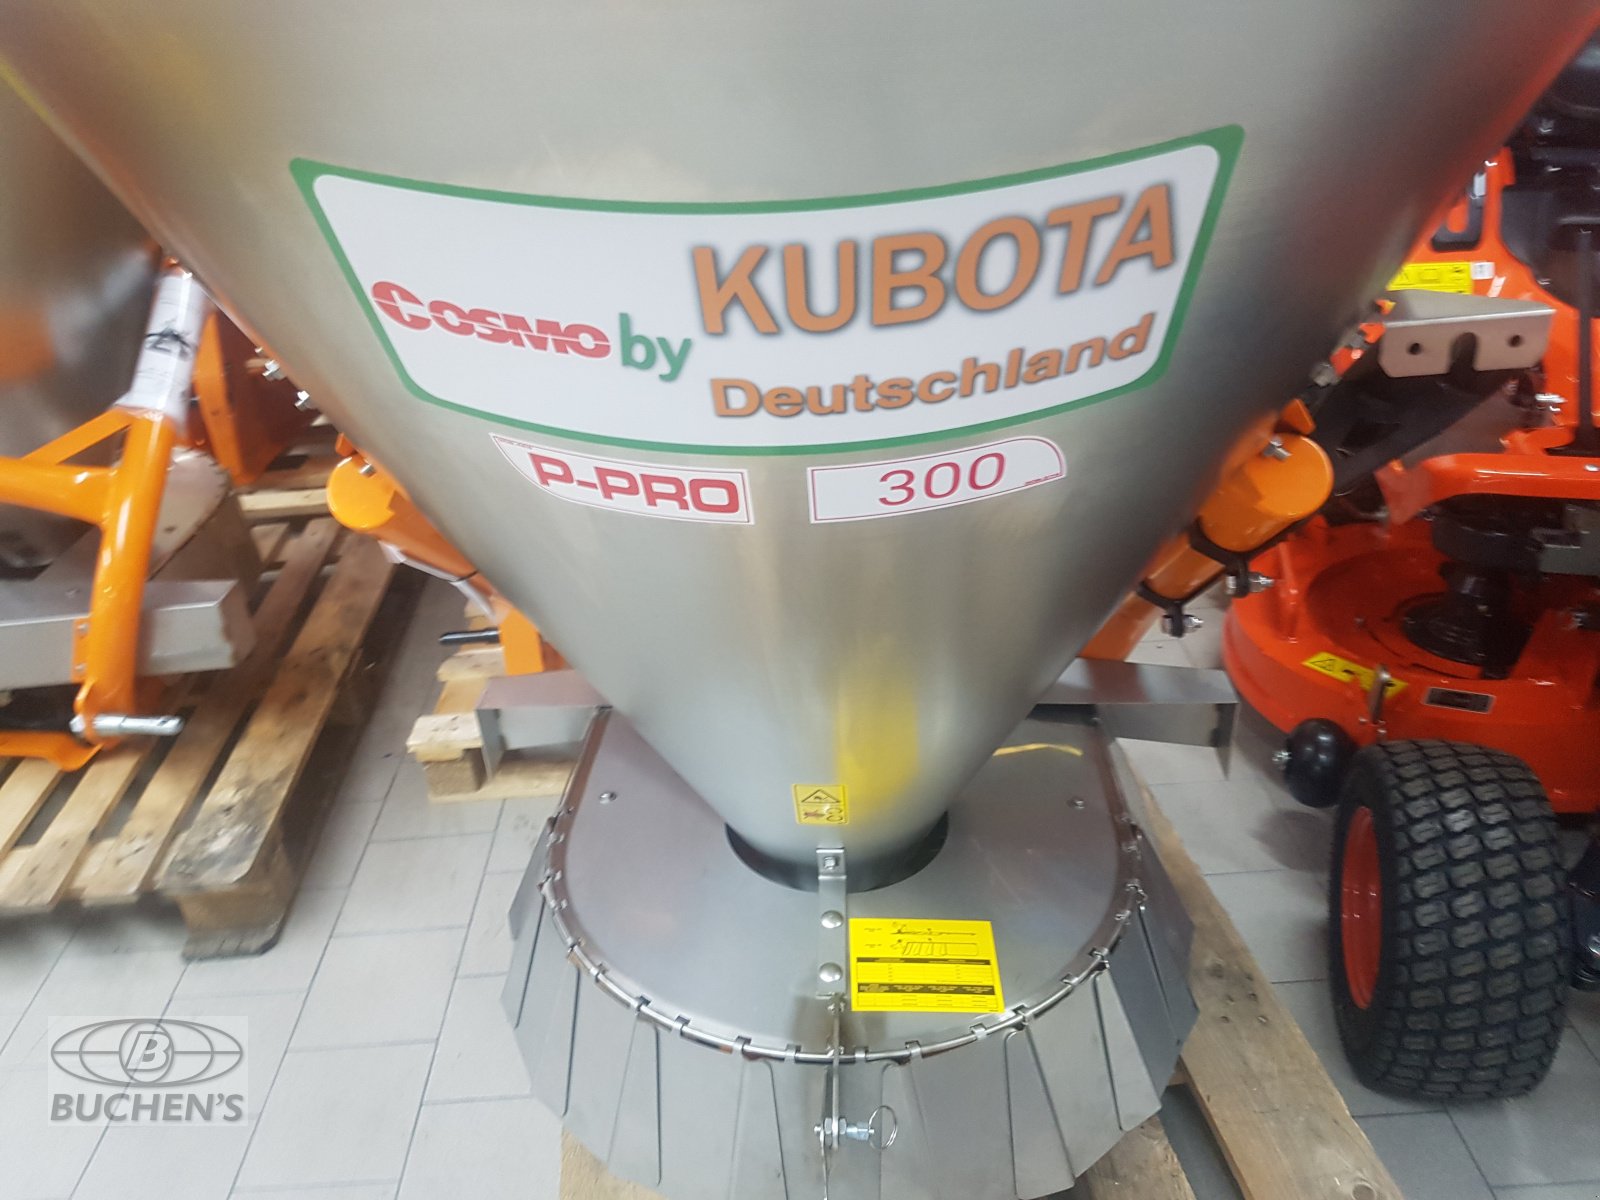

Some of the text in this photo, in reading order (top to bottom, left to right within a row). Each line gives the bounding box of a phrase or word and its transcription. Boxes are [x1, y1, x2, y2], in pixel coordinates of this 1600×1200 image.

[619, 312, 692, 382] by
[691, 182, 1176, 335] KUBOTA
[709, 312, 1156, 419] Deutschland
[528, 452, 740, 514] P-PRO
[878, 452, 1006, 507] 300
